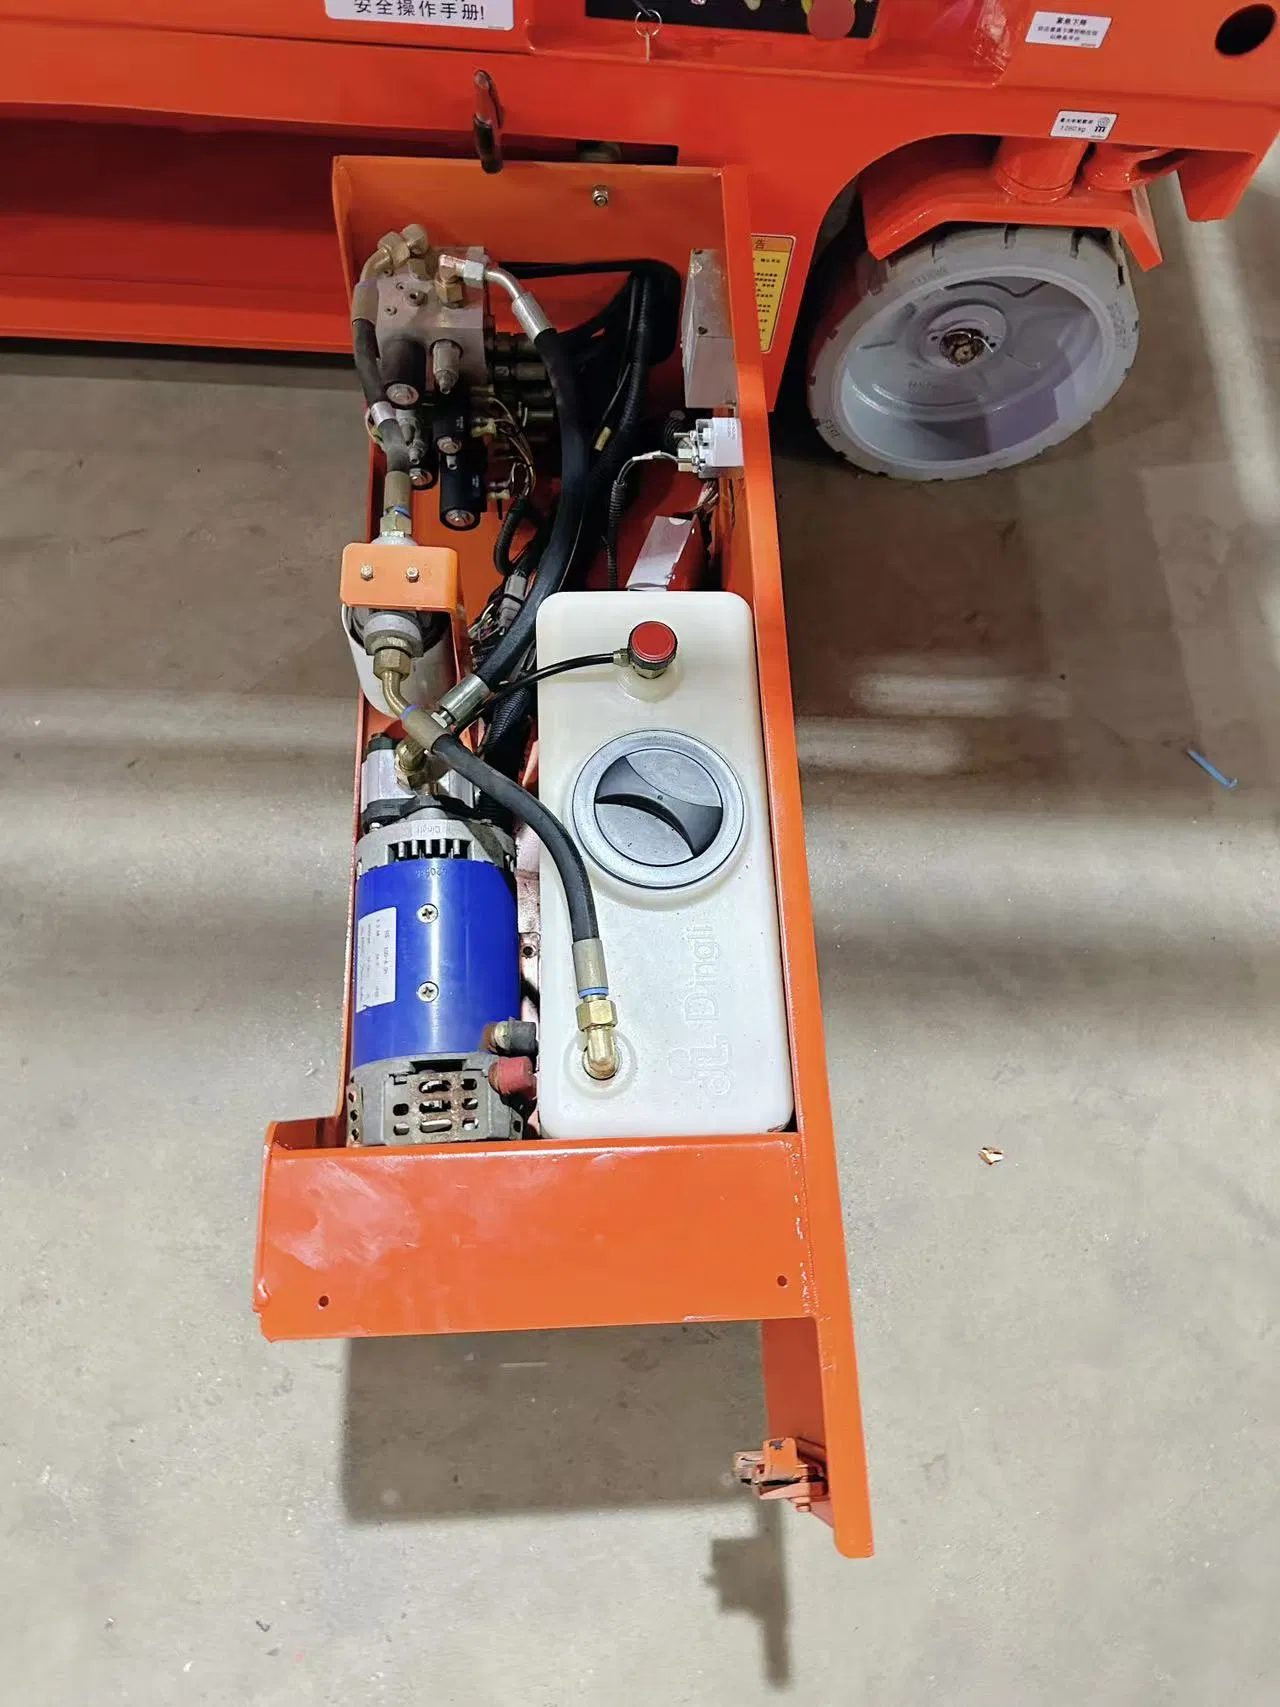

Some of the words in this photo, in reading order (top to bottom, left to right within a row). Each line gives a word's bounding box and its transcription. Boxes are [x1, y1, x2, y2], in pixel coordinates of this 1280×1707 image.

[354, 0, 485, 20] 安全操作手册!
[683, 922, 721, 1023] Dingli
